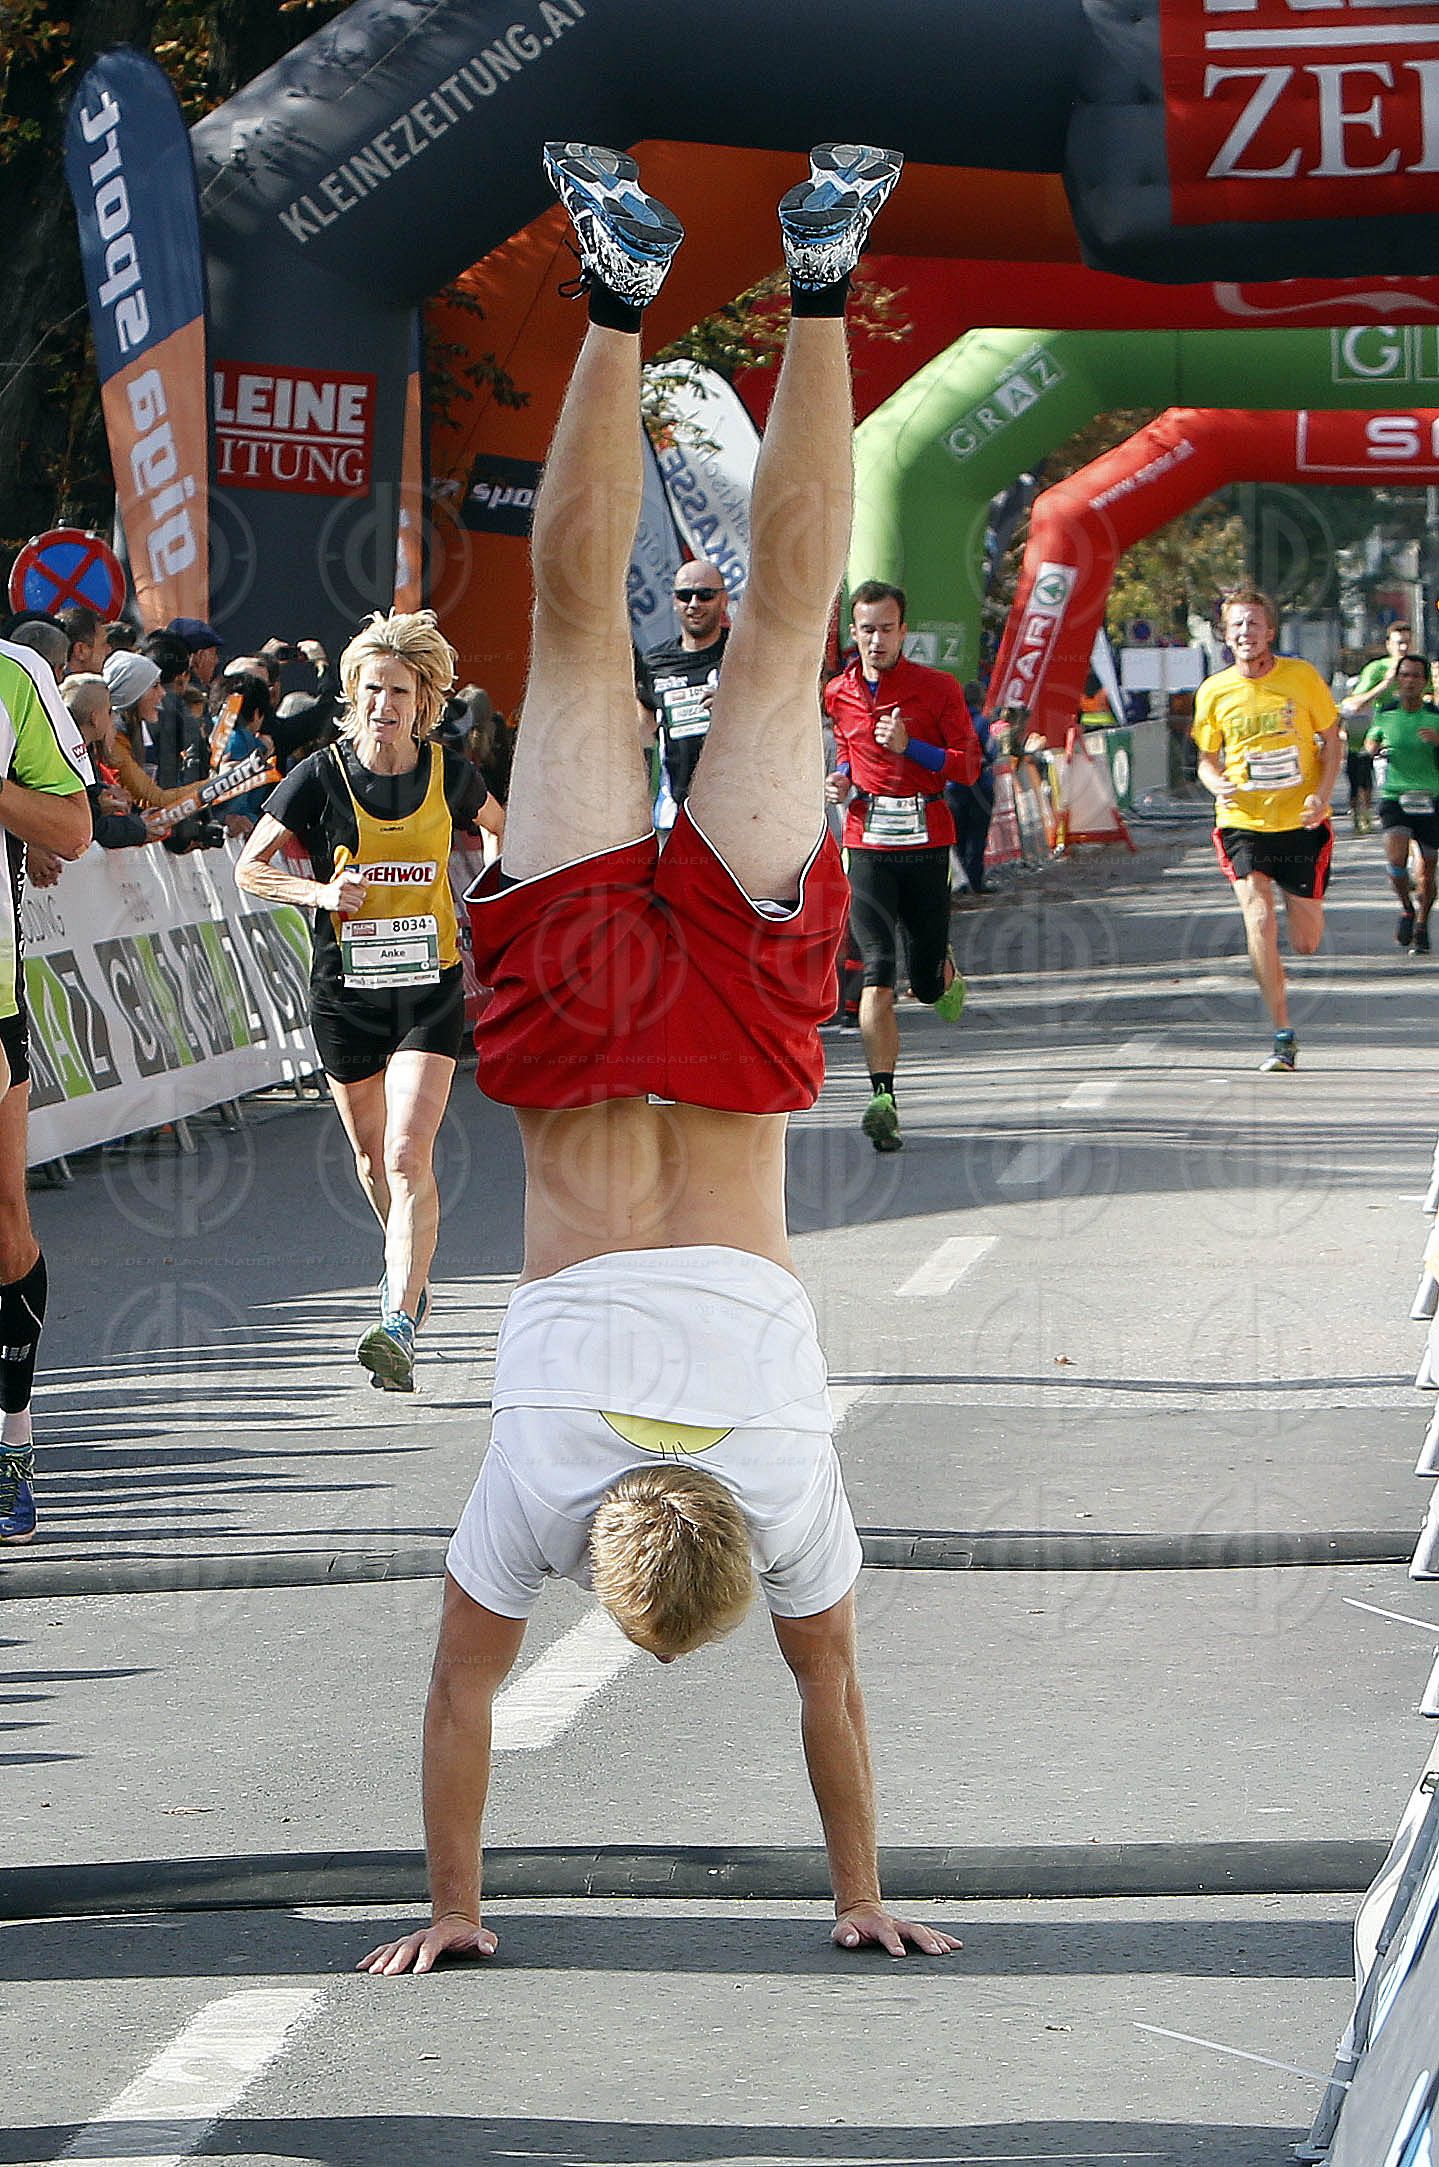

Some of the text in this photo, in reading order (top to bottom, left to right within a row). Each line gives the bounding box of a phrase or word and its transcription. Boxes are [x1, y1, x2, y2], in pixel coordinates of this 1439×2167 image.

[949, 359, 1063, 453] GRAZ
[219, 438, 365, 486] ITUNG
[472, 482, 537, 509] spo
[393, 919, 426, 932] 8034
[380, 949, 405, 958] Anke
